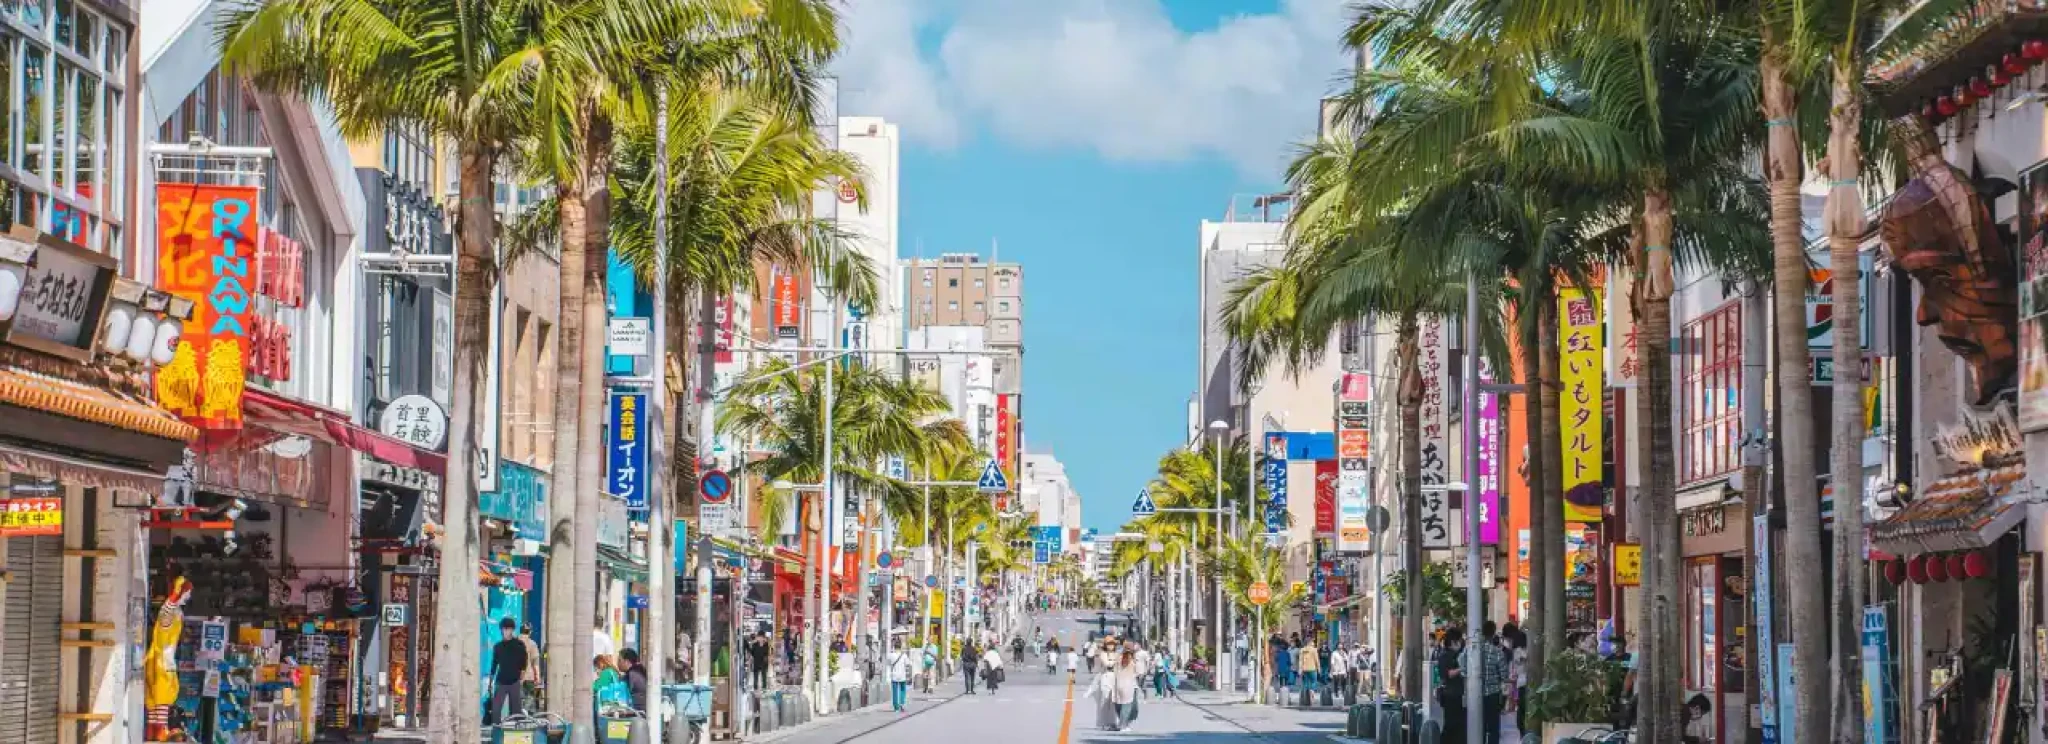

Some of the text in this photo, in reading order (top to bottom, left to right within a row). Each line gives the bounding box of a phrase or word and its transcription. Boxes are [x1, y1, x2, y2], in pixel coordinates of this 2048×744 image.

[208, 198, 251, 337] OKINAWA
[617, 441, 636, 497] イーオン
[1567, 331, 1597, 478] 紅いもタルト
